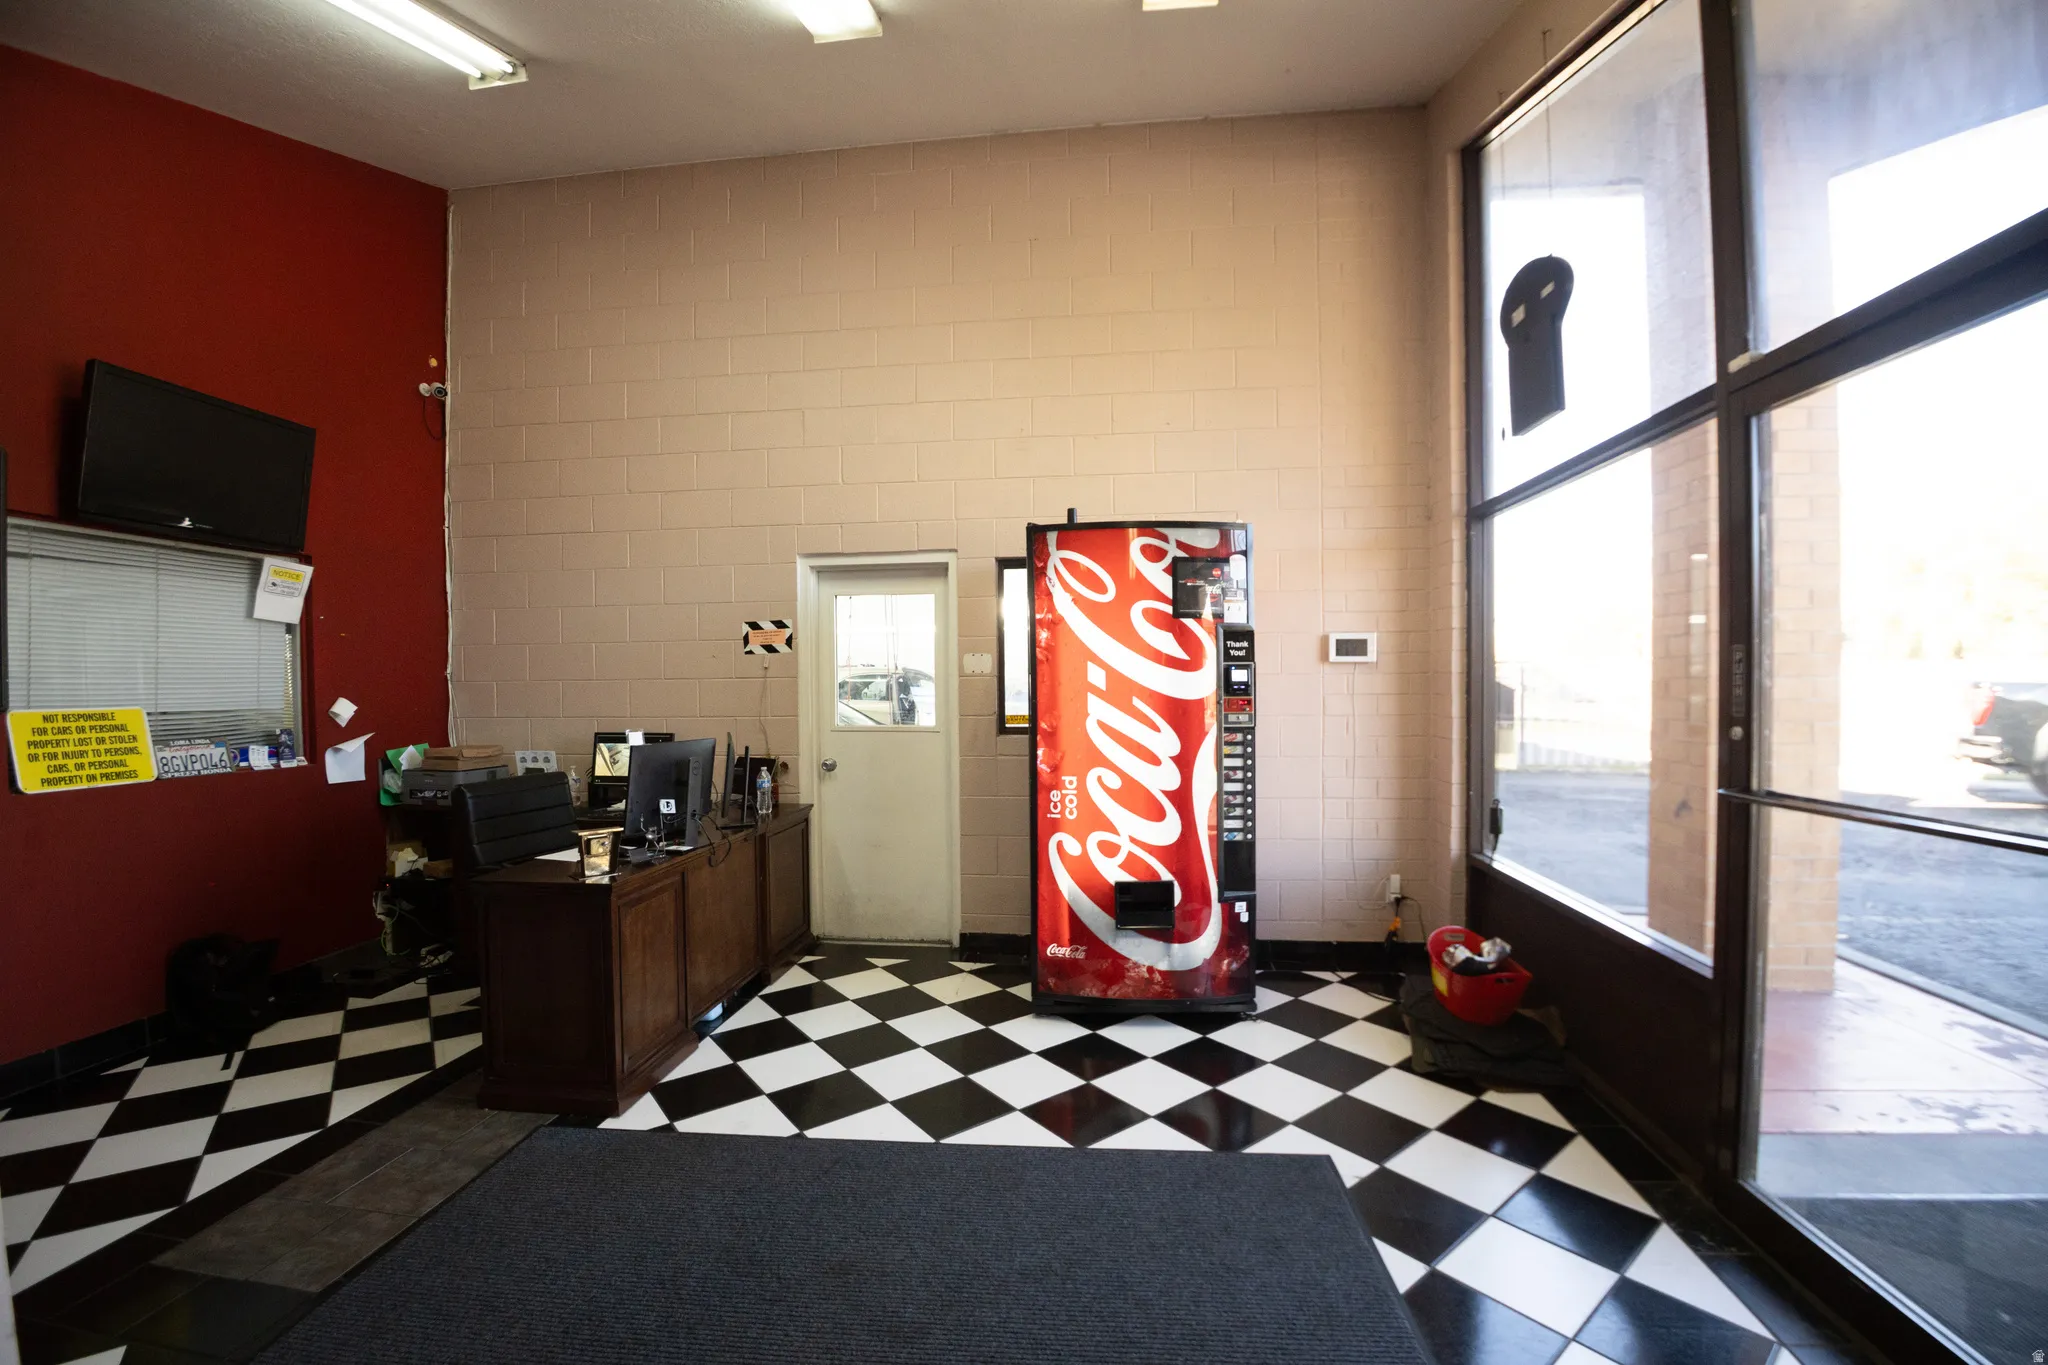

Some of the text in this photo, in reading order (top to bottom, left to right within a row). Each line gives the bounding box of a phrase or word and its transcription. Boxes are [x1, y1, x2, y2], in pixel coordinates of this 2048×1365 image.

[273, 570, 302, 580] NOTICE
[42, 712, 116, 724] NOT RESPONSIBLE
[32, 724, 130, 737] FOR CARS OR PERSONAL
[27, 735, 138, 750] PROPERTY LOST OR STOLEN
[28, 746, 143, 763] OR FOR INJURY TO PERSONS,
[47, 759, 129, 774] CARS, OR PERSONAL
[41, 770, 139, 787] PROPERTY ON PREMISES
[1047, 790, 1062, 819] ice
[1062, 776, 1078, 820] cold
